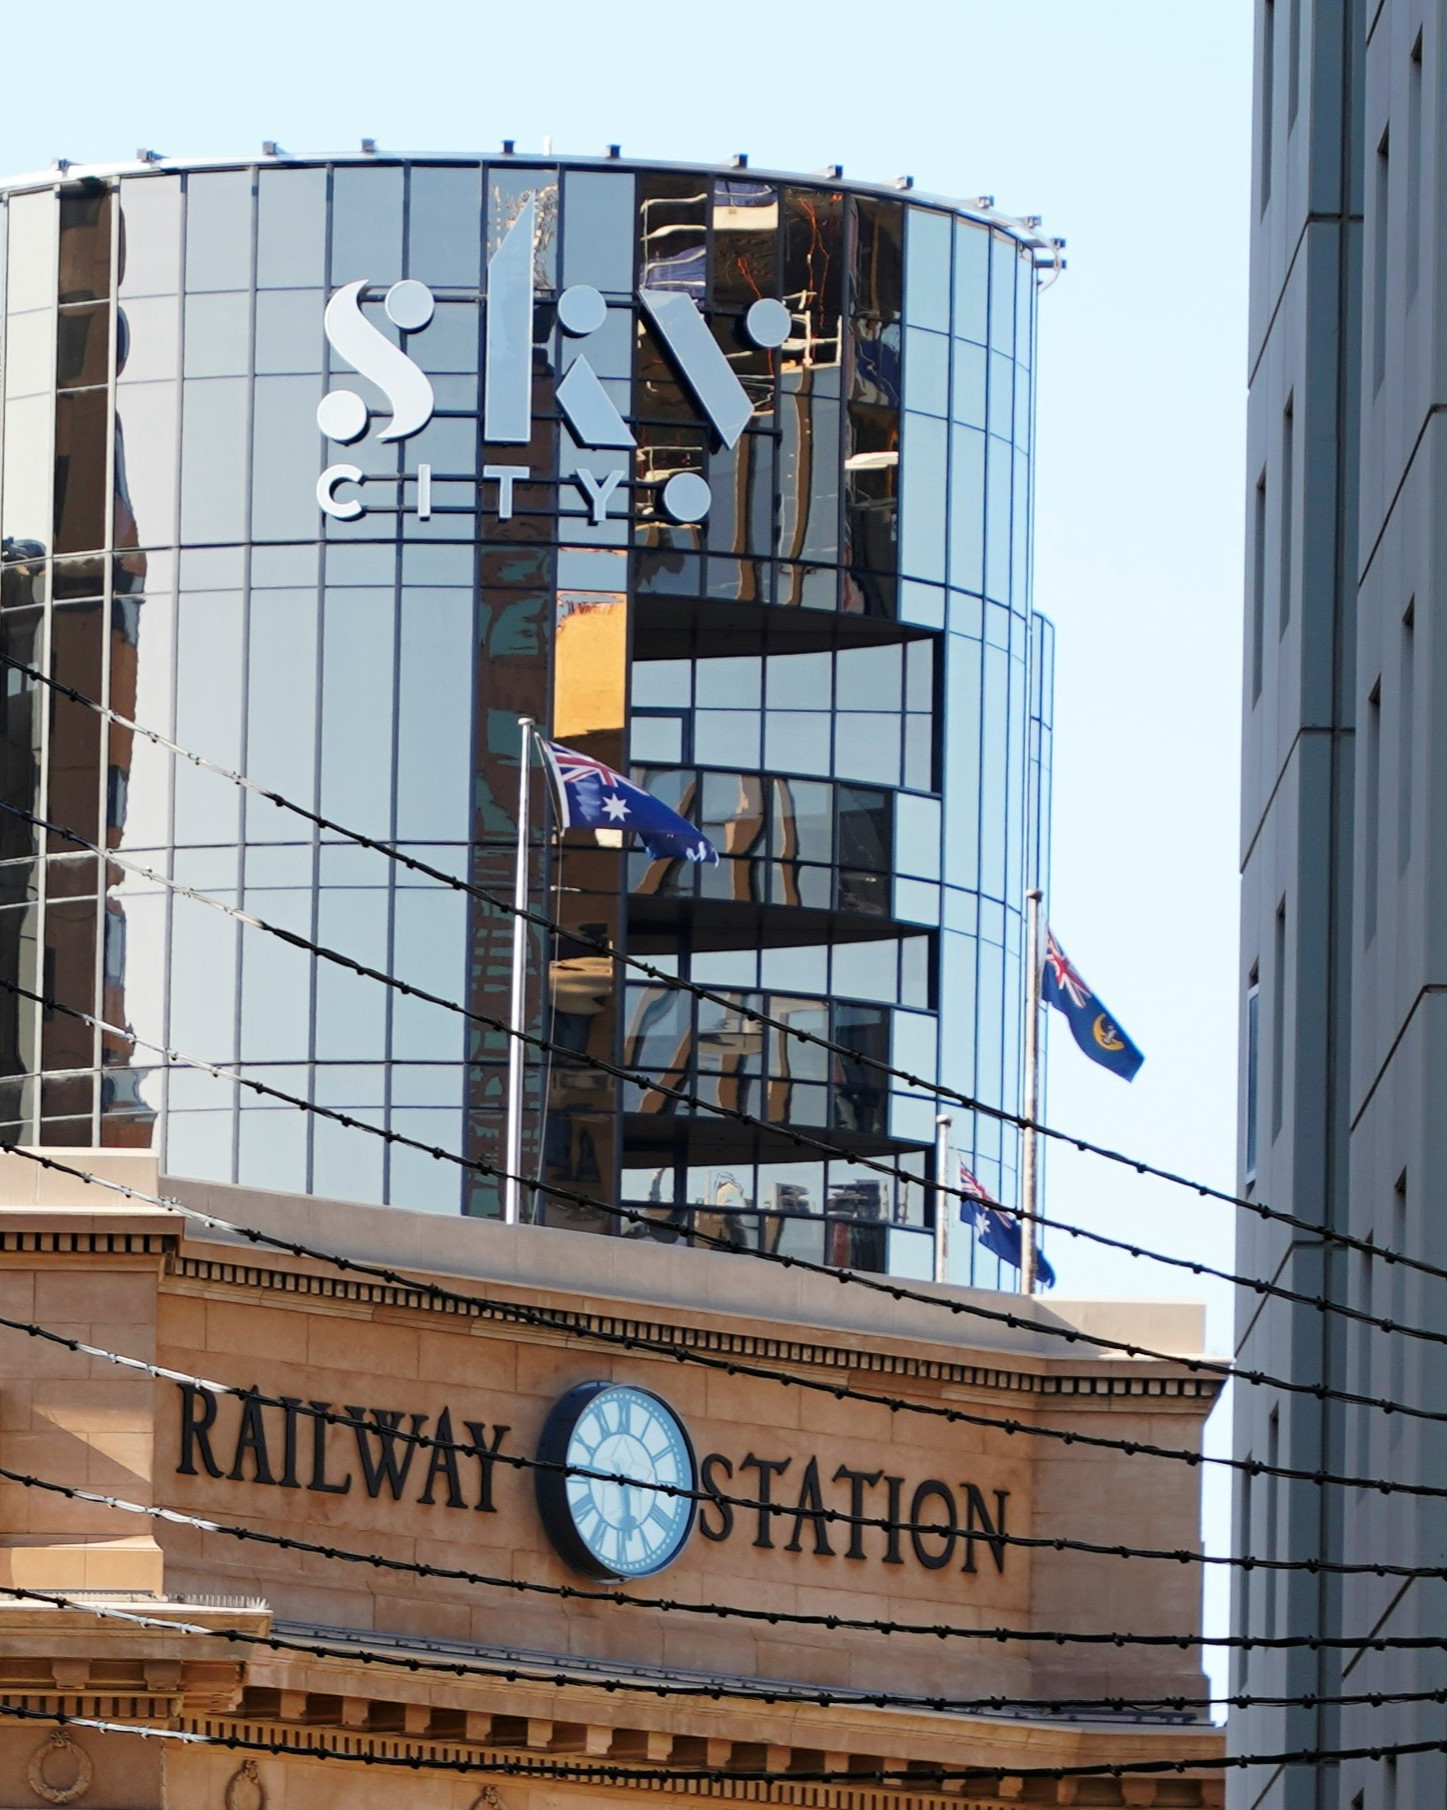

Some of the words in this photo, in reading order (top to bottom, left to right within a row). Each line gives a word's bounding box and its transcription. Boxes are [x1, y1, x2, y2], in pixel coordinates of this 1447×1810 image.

[316, 464, 626, 522] CITY
[175, 1382, 513, 1513] RAILWAY
[700, 1453, 1010, 1573] STATION
